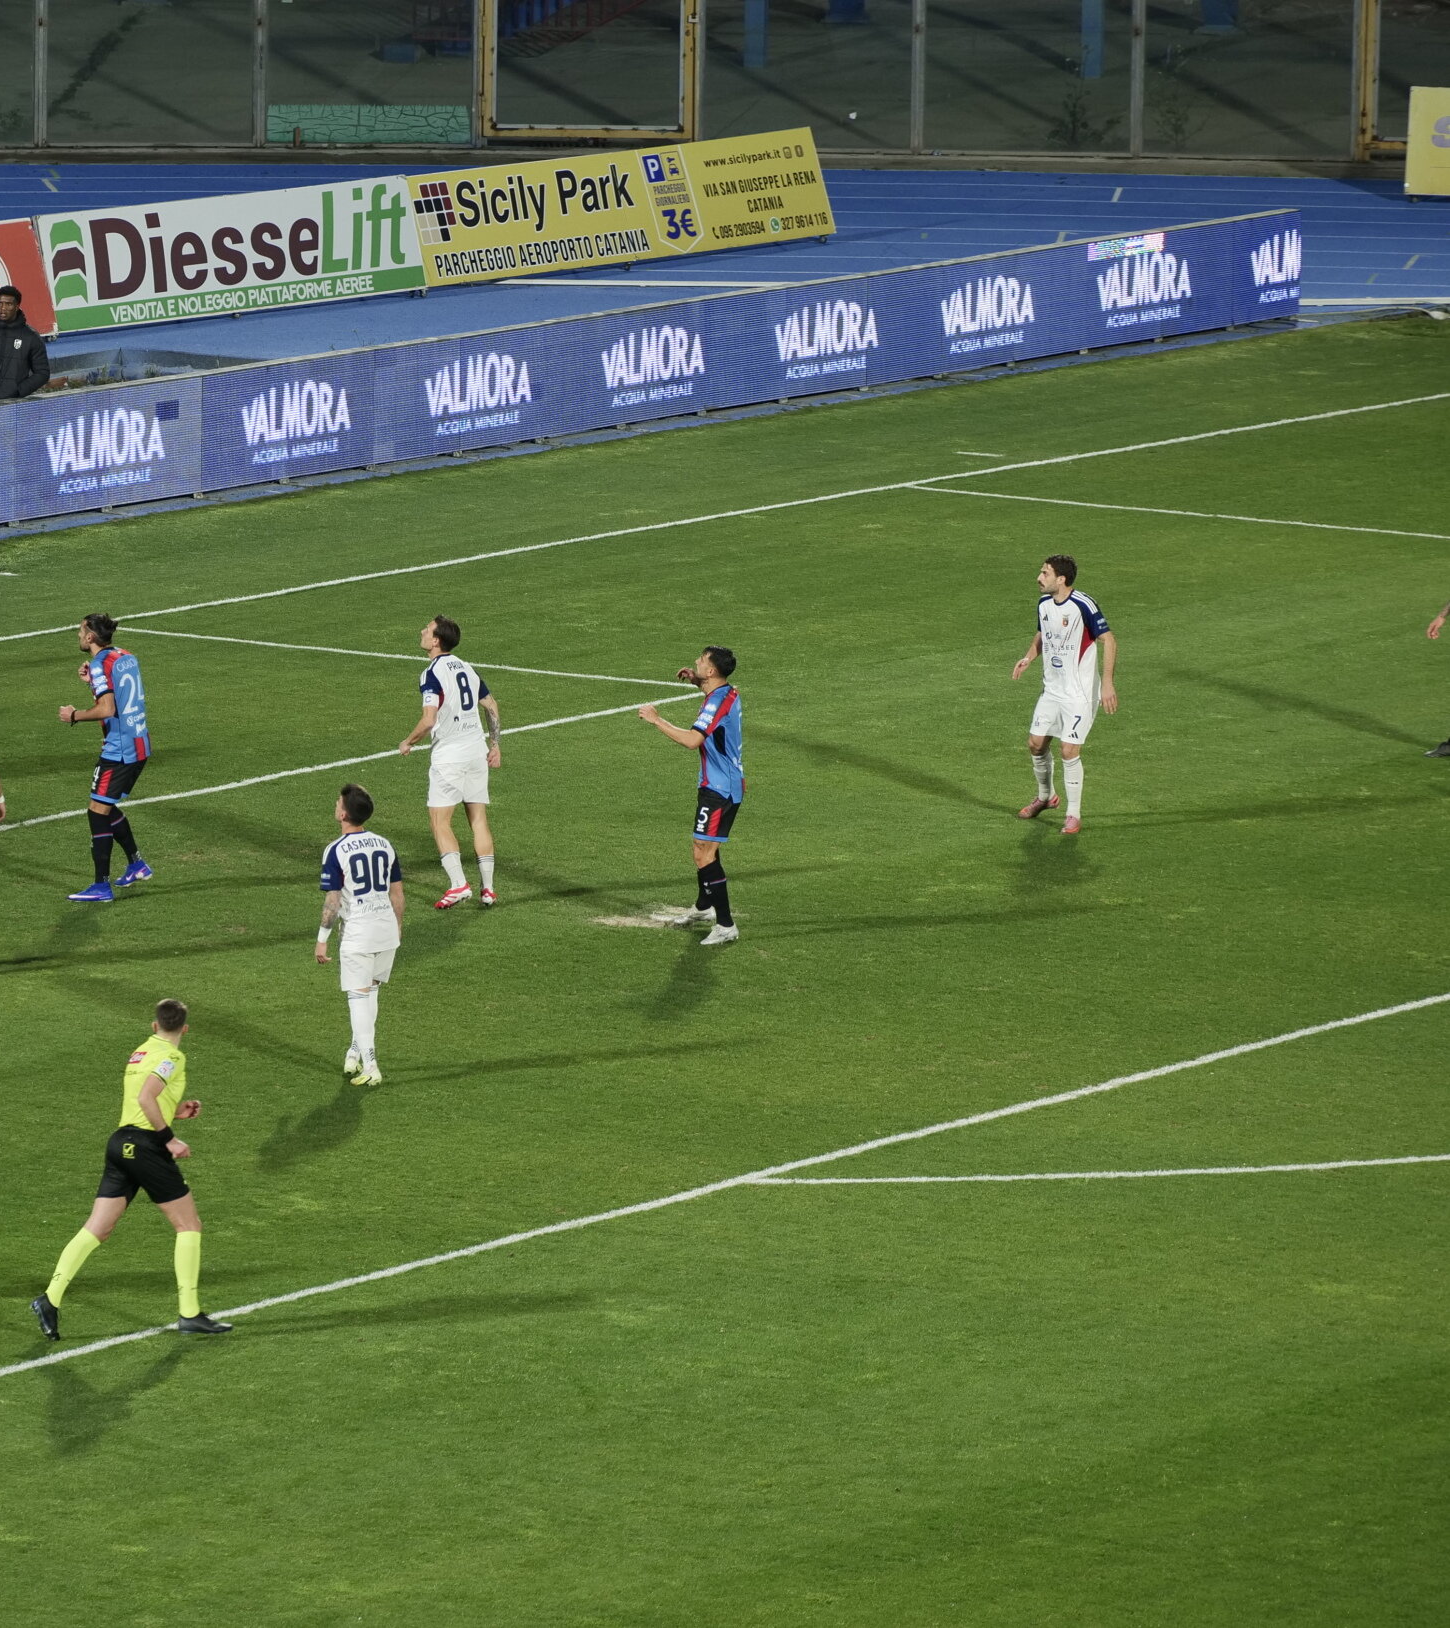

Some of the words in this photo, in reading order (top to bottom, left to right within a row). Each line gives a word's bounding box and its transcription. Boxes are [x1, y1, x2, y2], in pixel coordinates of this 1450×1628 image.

[703, 149, 781, 168] www.sicilypark.it
[455, 174, 546, 232] Sicily
[555, 163, 635, 216] Park
[653, 183, 686, 195] PARCHEGGIO
[703, 182, 719, 198] VIA
[721, 180, 739, 196] SAN
[739, 175, 781, 194] GIUSEPPE
[781, 174, 793, 188] LA
[794, 170, 817, 186] RENA
[747, 196, 784, 213] CATANIA
[661, 208, 697, 240] 3€
[719, 225, 734, 240] 095
[735, 221, 766, 237] 2903594
[781, 215, 795, 231] 327
[434, 245, 517, 278] PARCHEGGIO
[518, 235, 594, 268] AEROPORTO
[594, 228, 650, 257] CATANIA
[1097, 250, 1191, 312] VALMORA
[109, 302, 166, 323] VENDITA
[168, 300, 177, 317] E
[178, 290, 246, 314] NOLEGGIO
[248, 281, 334, 307] PIATTAFORME
[334, 274, 374, 295] AEREE
[941, 274, 1035, 337] VALMORA
[1259, 290, 1288, 304] ACQUA
[1106, 312, 1139, 328] ACQUA
[1140, 304, 1181, 321] MINERALE
[774, 299, 879, 362] VALMORA
[949, 338, 981, 355] ACQUA
[983, 331, 1024, 349] MINERALE
[602, 325, 705, 389] VALMORA
[785, 363, 820, 380] ACQUA
[822, 355, 866, 374] MINERALE
[425, 352, 532, 419] VALMORA
[612, 389, 646, 408] ACQUA
[648, 381, 693, 401] MINERALE
[241, 379, 351, 446] VALMORA
[436, 419, 472, 436] ACQUA
[474, 410, 520, 430] MINERALE
[47, 407, 166, 477] VALMORA
[252, 447, 290, 465] ACQUA
[291, 439, 339, 459] MINERALE
[59, 476, 97, 495] ACQUA
[100, 467, 151, 489] MINERALE
[456, 671, 474, 711] 8
[1072, 715, 1082, 731] 7
[697, 806, 709, 824] 5
[341, 838, 388, 854] CASAROTTO
[349, 850, 389, 896] 90
